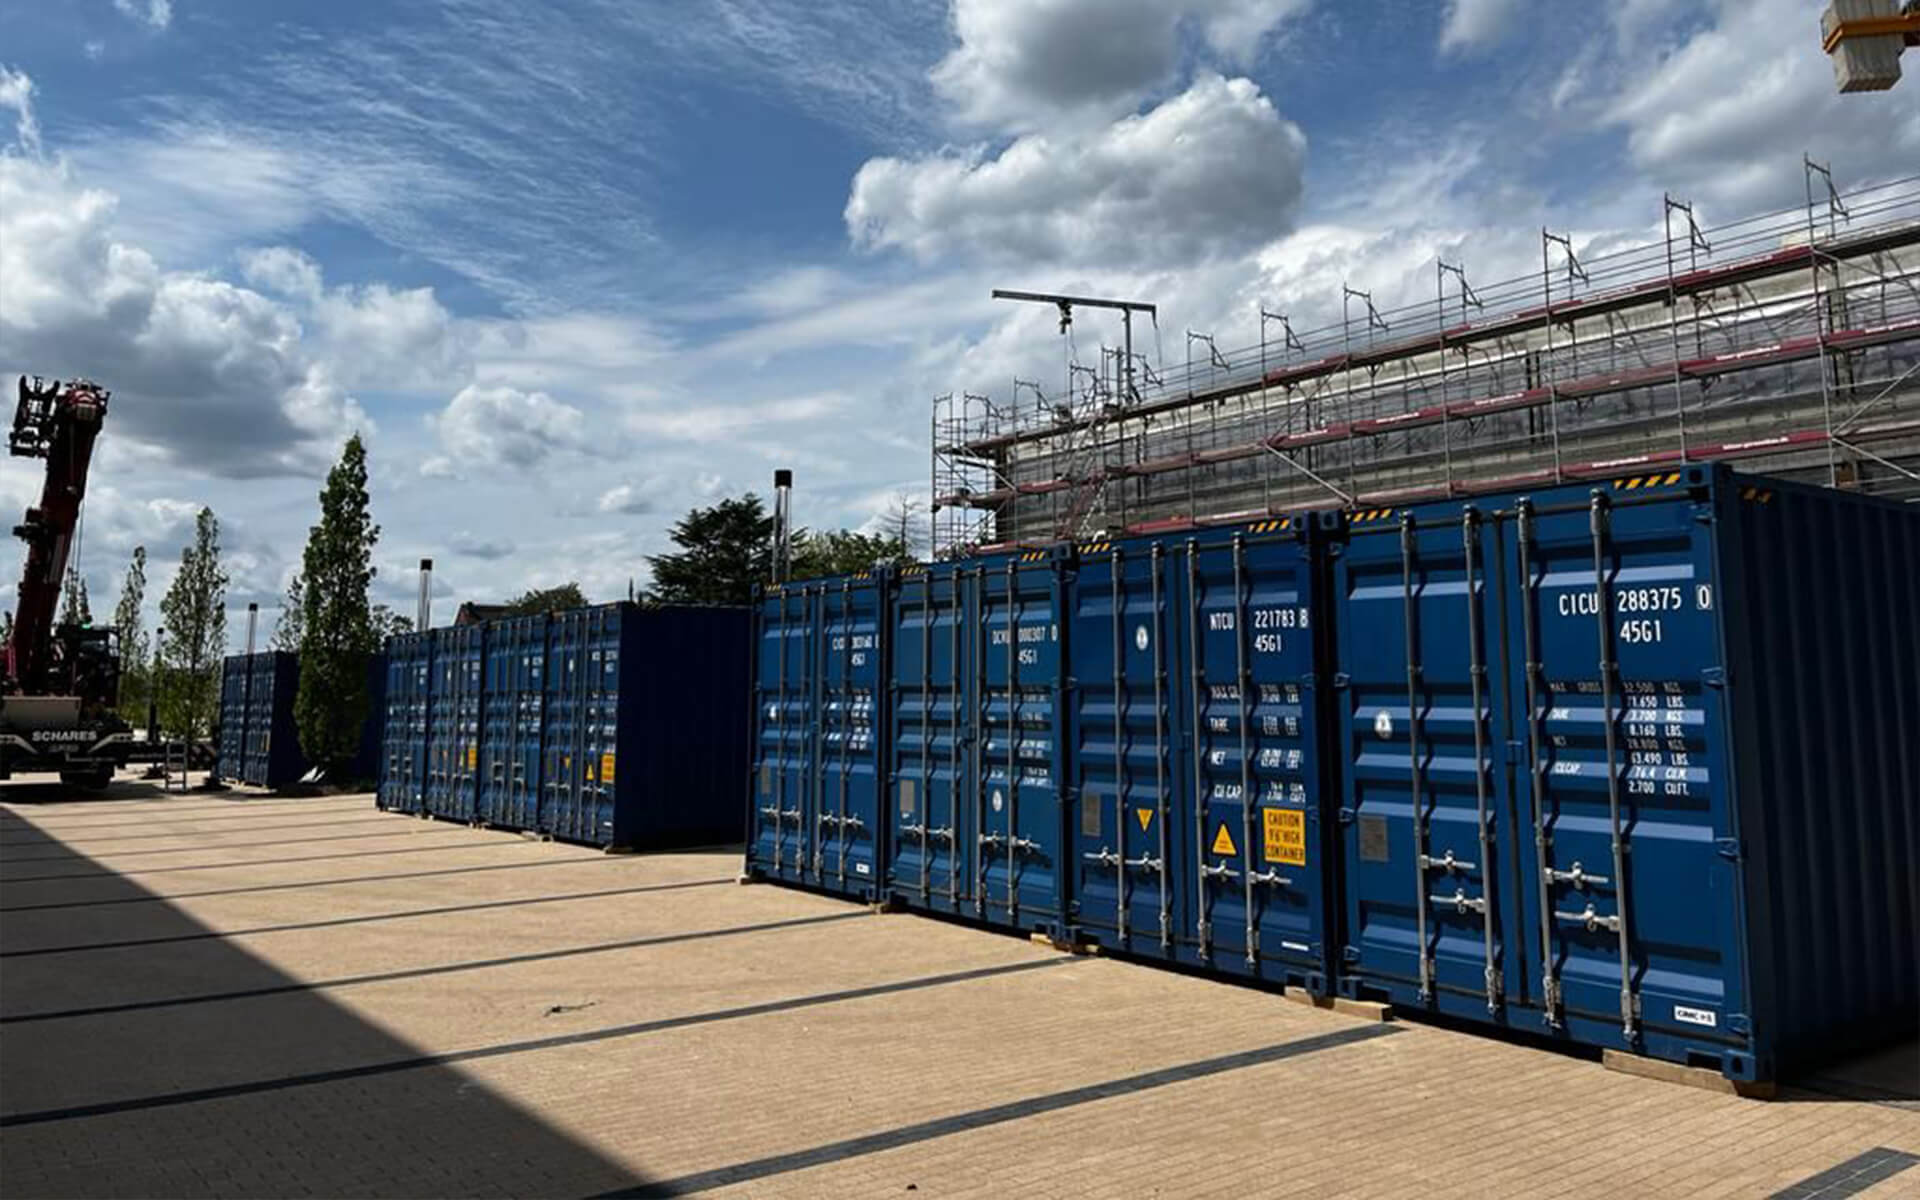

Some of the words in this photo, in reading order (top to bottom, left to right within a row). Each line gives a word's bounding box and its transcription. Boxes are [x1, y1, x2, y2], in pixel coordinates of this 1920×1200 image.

[1559, 592, 1599, 616] CICU
[1617, 587, 1682, 612] 288375
[1698, 585, 1711, 610] 0
[1254, 609, 1296, 629] 221783
[1619, 618, 1662, 643] 45G1
[1254, 633, 1282, 652] 45G1
[32, 730, 97, 742] SCHARES
[1268, 811, 1300, 828] CAUTION
